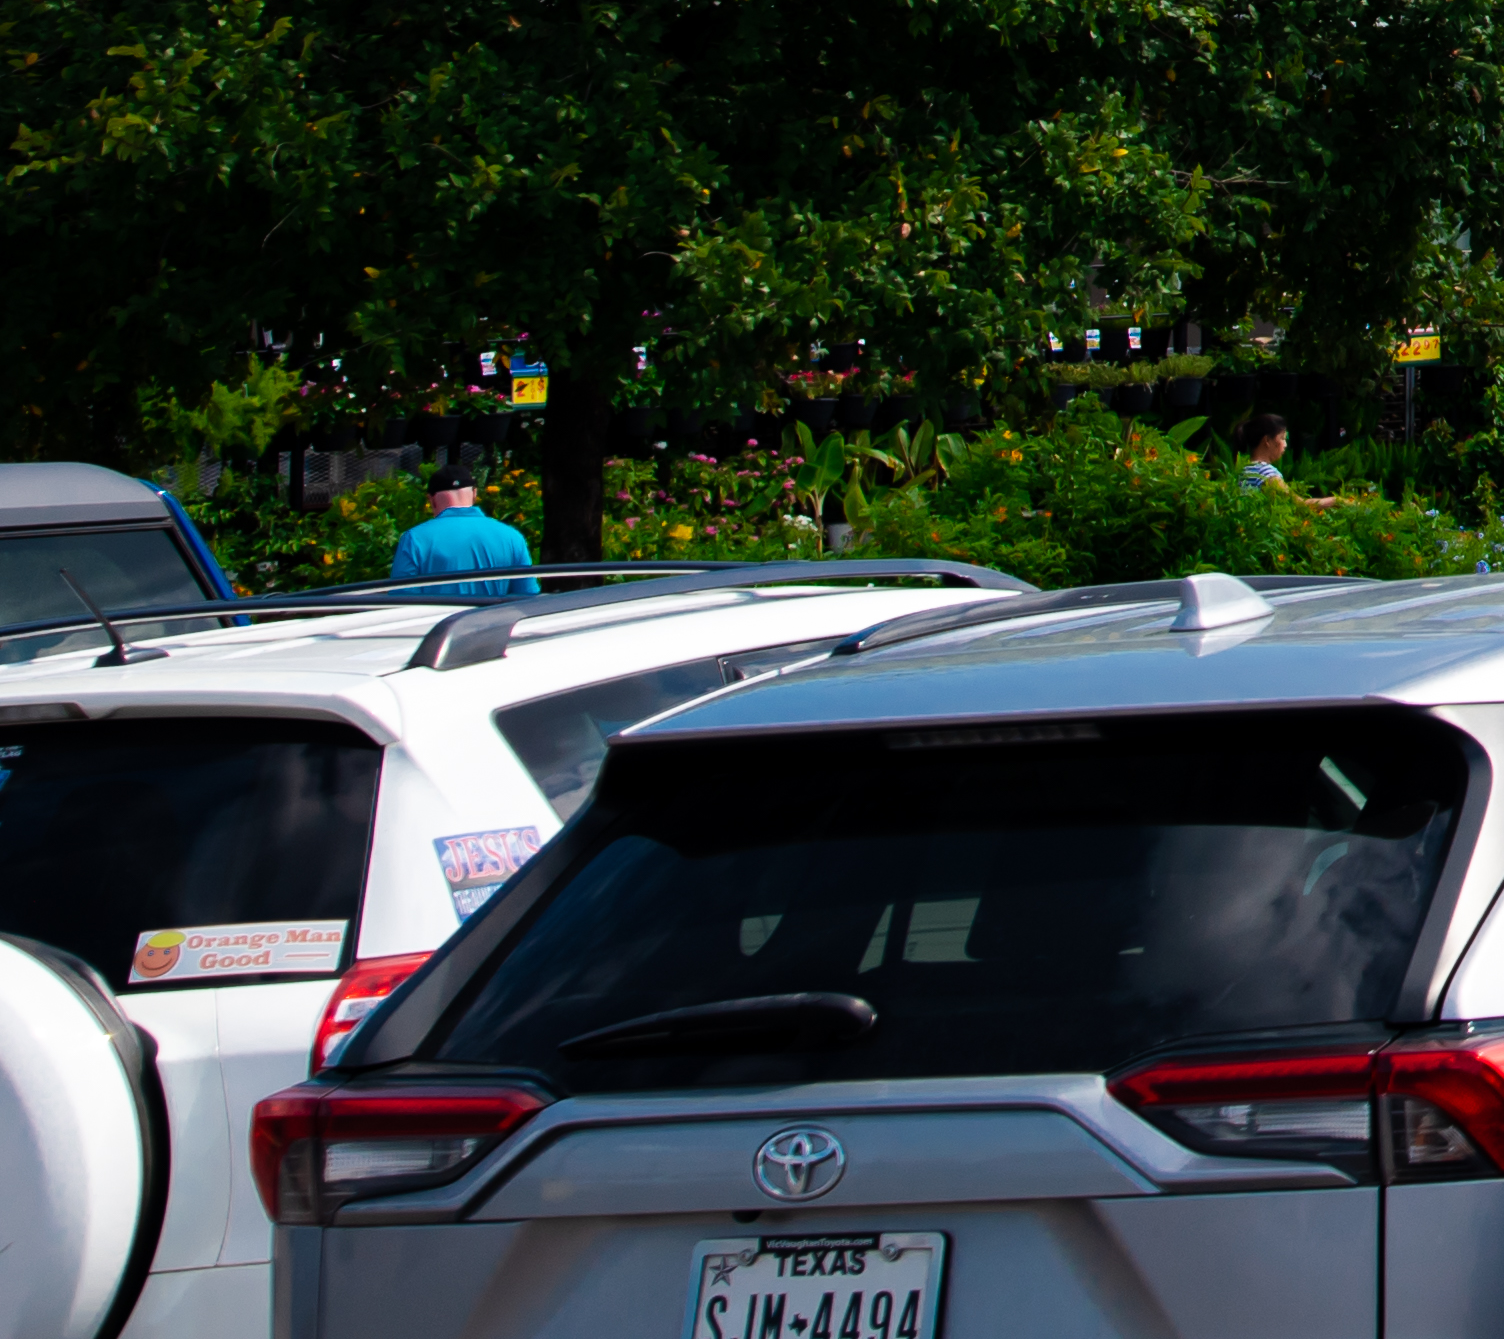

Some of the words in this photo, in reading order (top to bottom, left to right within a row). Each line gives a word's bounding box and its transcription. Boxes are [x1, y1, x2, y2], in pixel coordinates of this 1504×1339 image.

[187, 933, 280, 950] Orange
[283, 929, 341, 944] Man
[200, 950, 272, 970] Good
[774, 1250, 866, 1277] TEXAS
